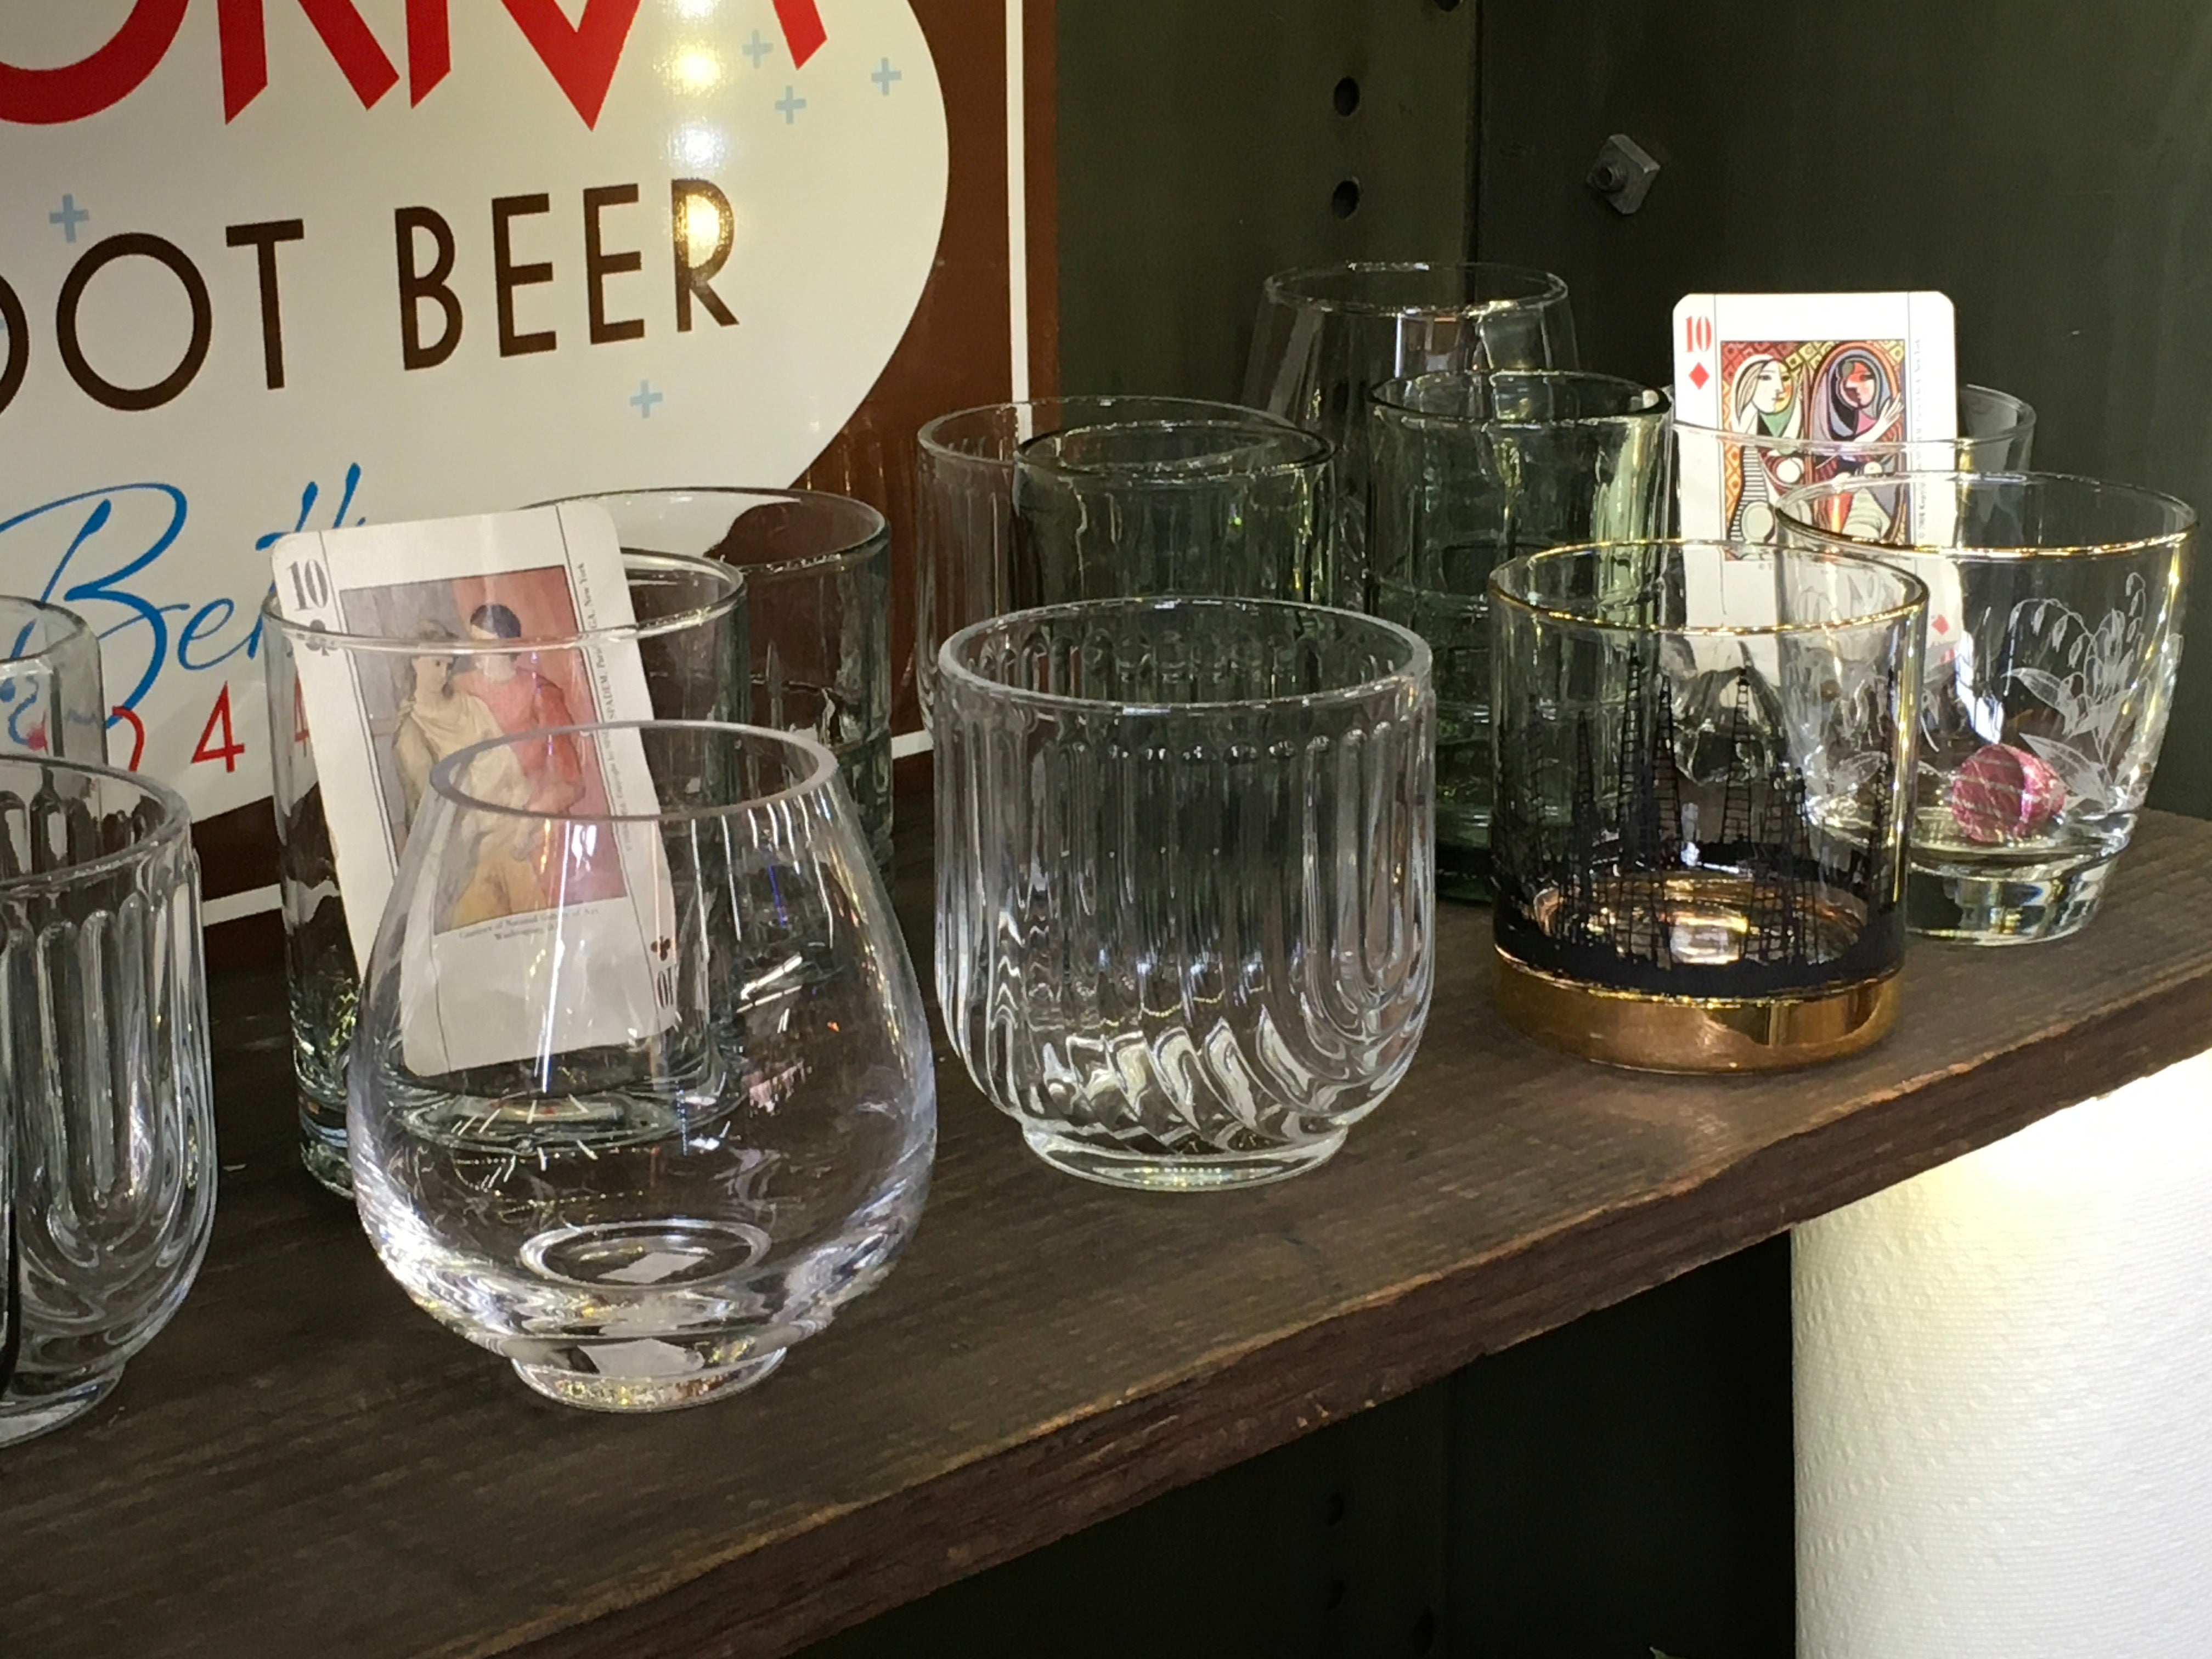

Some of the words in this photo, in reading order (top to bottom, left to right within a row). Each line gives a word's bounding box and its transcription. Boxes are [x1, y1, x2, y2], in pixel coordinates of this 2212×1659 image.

[0, 218, 304, 414] OT
[394, 177, 740, 371] BEER
[1685, 315, 1712, 352] 10
[286, 558, 328, 612] 10
[657, 966, 674, 1009] 10
